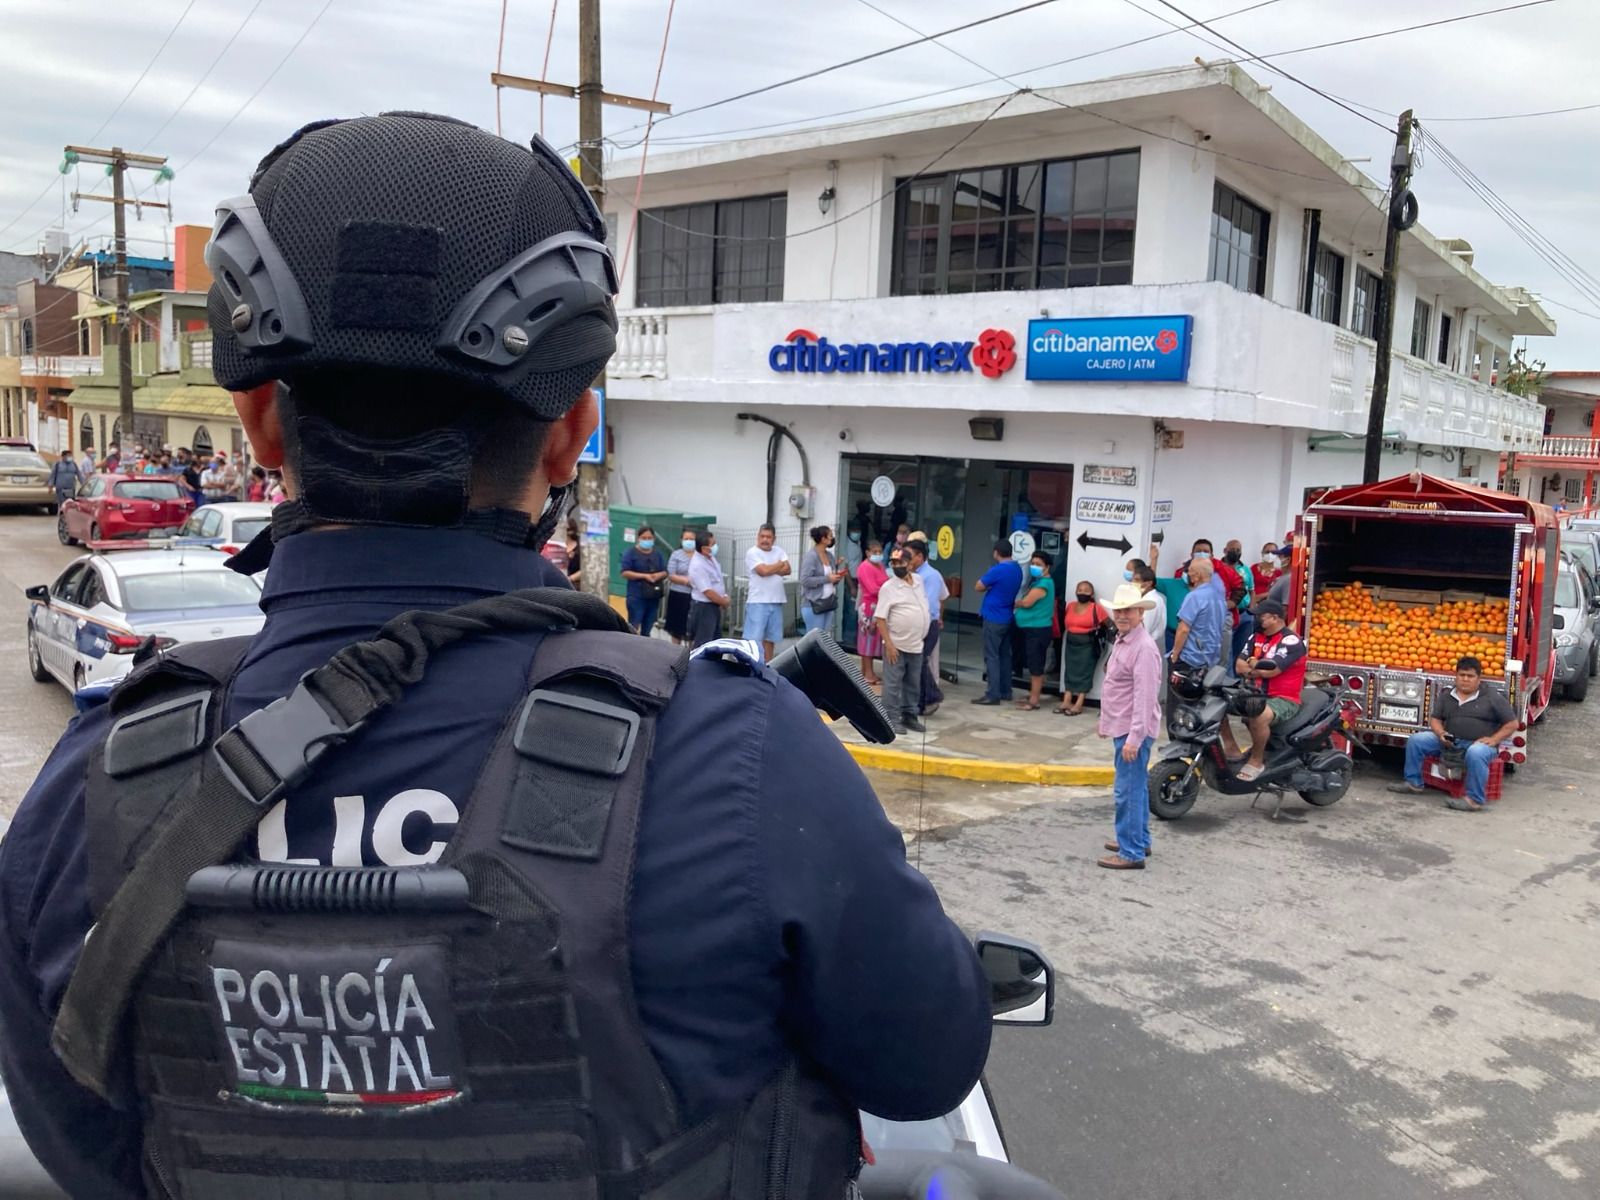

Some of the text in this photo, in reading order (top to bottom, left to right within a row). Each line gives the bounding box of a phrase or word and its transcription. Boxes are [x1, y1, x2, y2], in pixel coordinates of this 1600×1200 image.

[769, 332, 975, 373] citibanamex
[1033, 331, 1156, 353] citibanamex
[1086, 358, 1156, 369] CAJERO ATM
[1079, 501, 1098, 511] CALLE
[1104, 503, 1114, 512] DE
[1114, 503, 1135, 514] MAYO
[1513, 561, 1524, 636] NISSAN
[258, 788, 460, 867] LIC
[213, 958, 436, 1032] POLICÍA
[225, 1026, 451, 1091] ESTATAL
